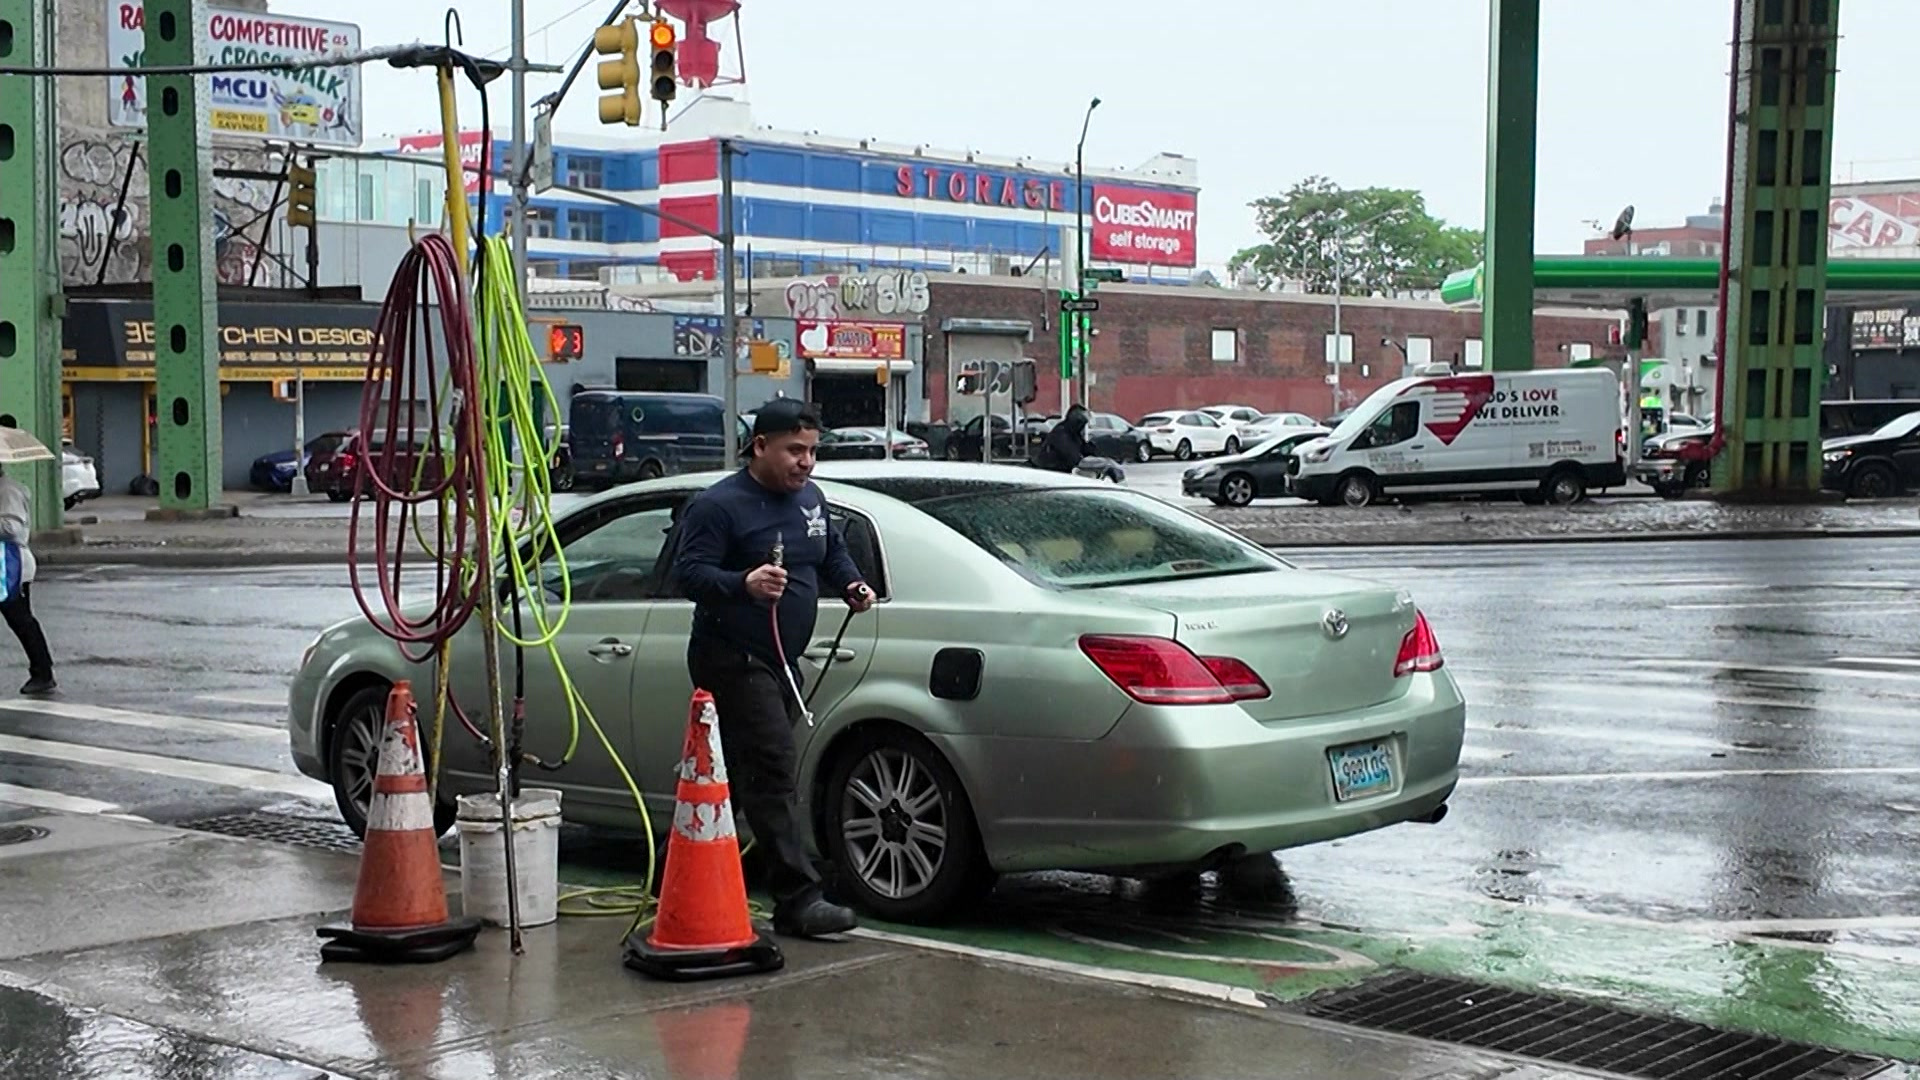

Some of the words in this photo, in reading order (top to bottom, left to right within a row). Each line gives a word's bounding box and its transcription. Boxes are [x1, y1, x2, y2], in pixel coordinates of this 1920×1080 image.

[210, 15, 329, 53] COMPETITIVE
[212, 76, 267, 100] MCU
[896, 165, 1064, 211] STORAGE
[1109, 230, 1132, 247] self
[1134, 233, 1181, 255] storage
[572, 332, 581, 353] 3
[1487, 390, 1518, 403] OD'S
[1522, 388, 1558, 402] LOVE
[1474, 406, 1497, 419] WE
[1501, 404, 1560, 419] DELIVER
